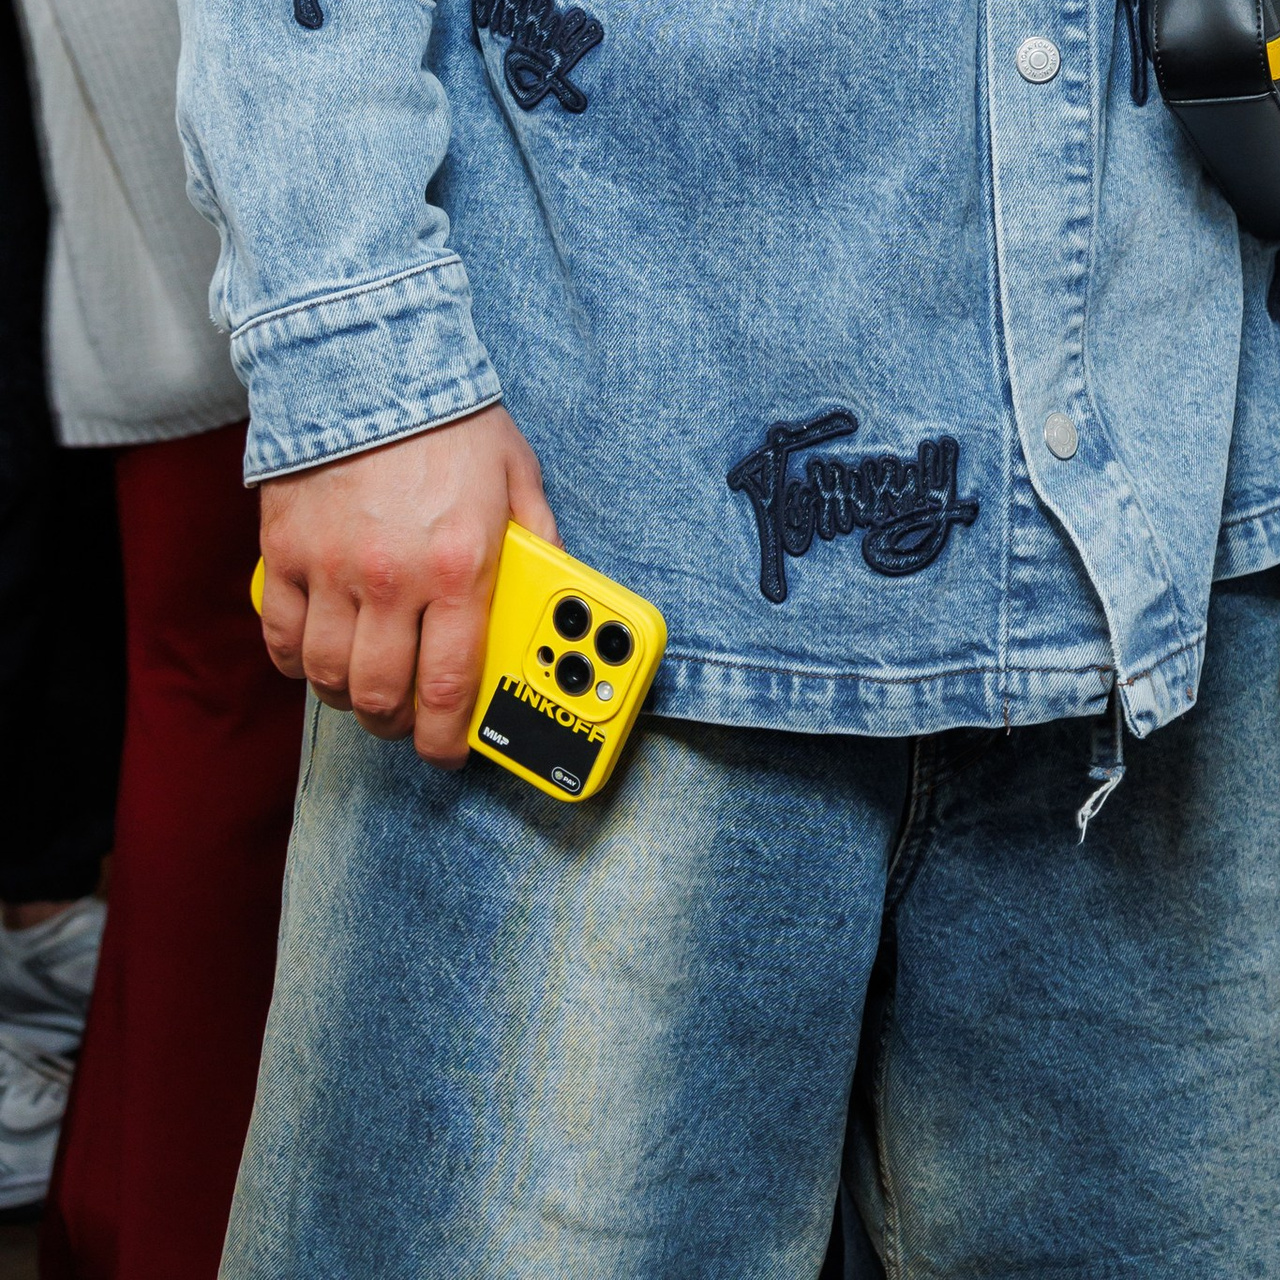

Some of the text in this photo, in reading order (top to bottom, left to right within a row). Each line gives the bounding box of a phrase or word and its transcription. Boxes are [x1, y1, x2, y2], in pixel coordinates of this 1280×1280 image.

[726, 406, 981, 605] Tommy
[502, 676, 606, 744] TINKOFF
[482, 726, 510, 746] МИР
[562, 775, 577, 787] PAY
